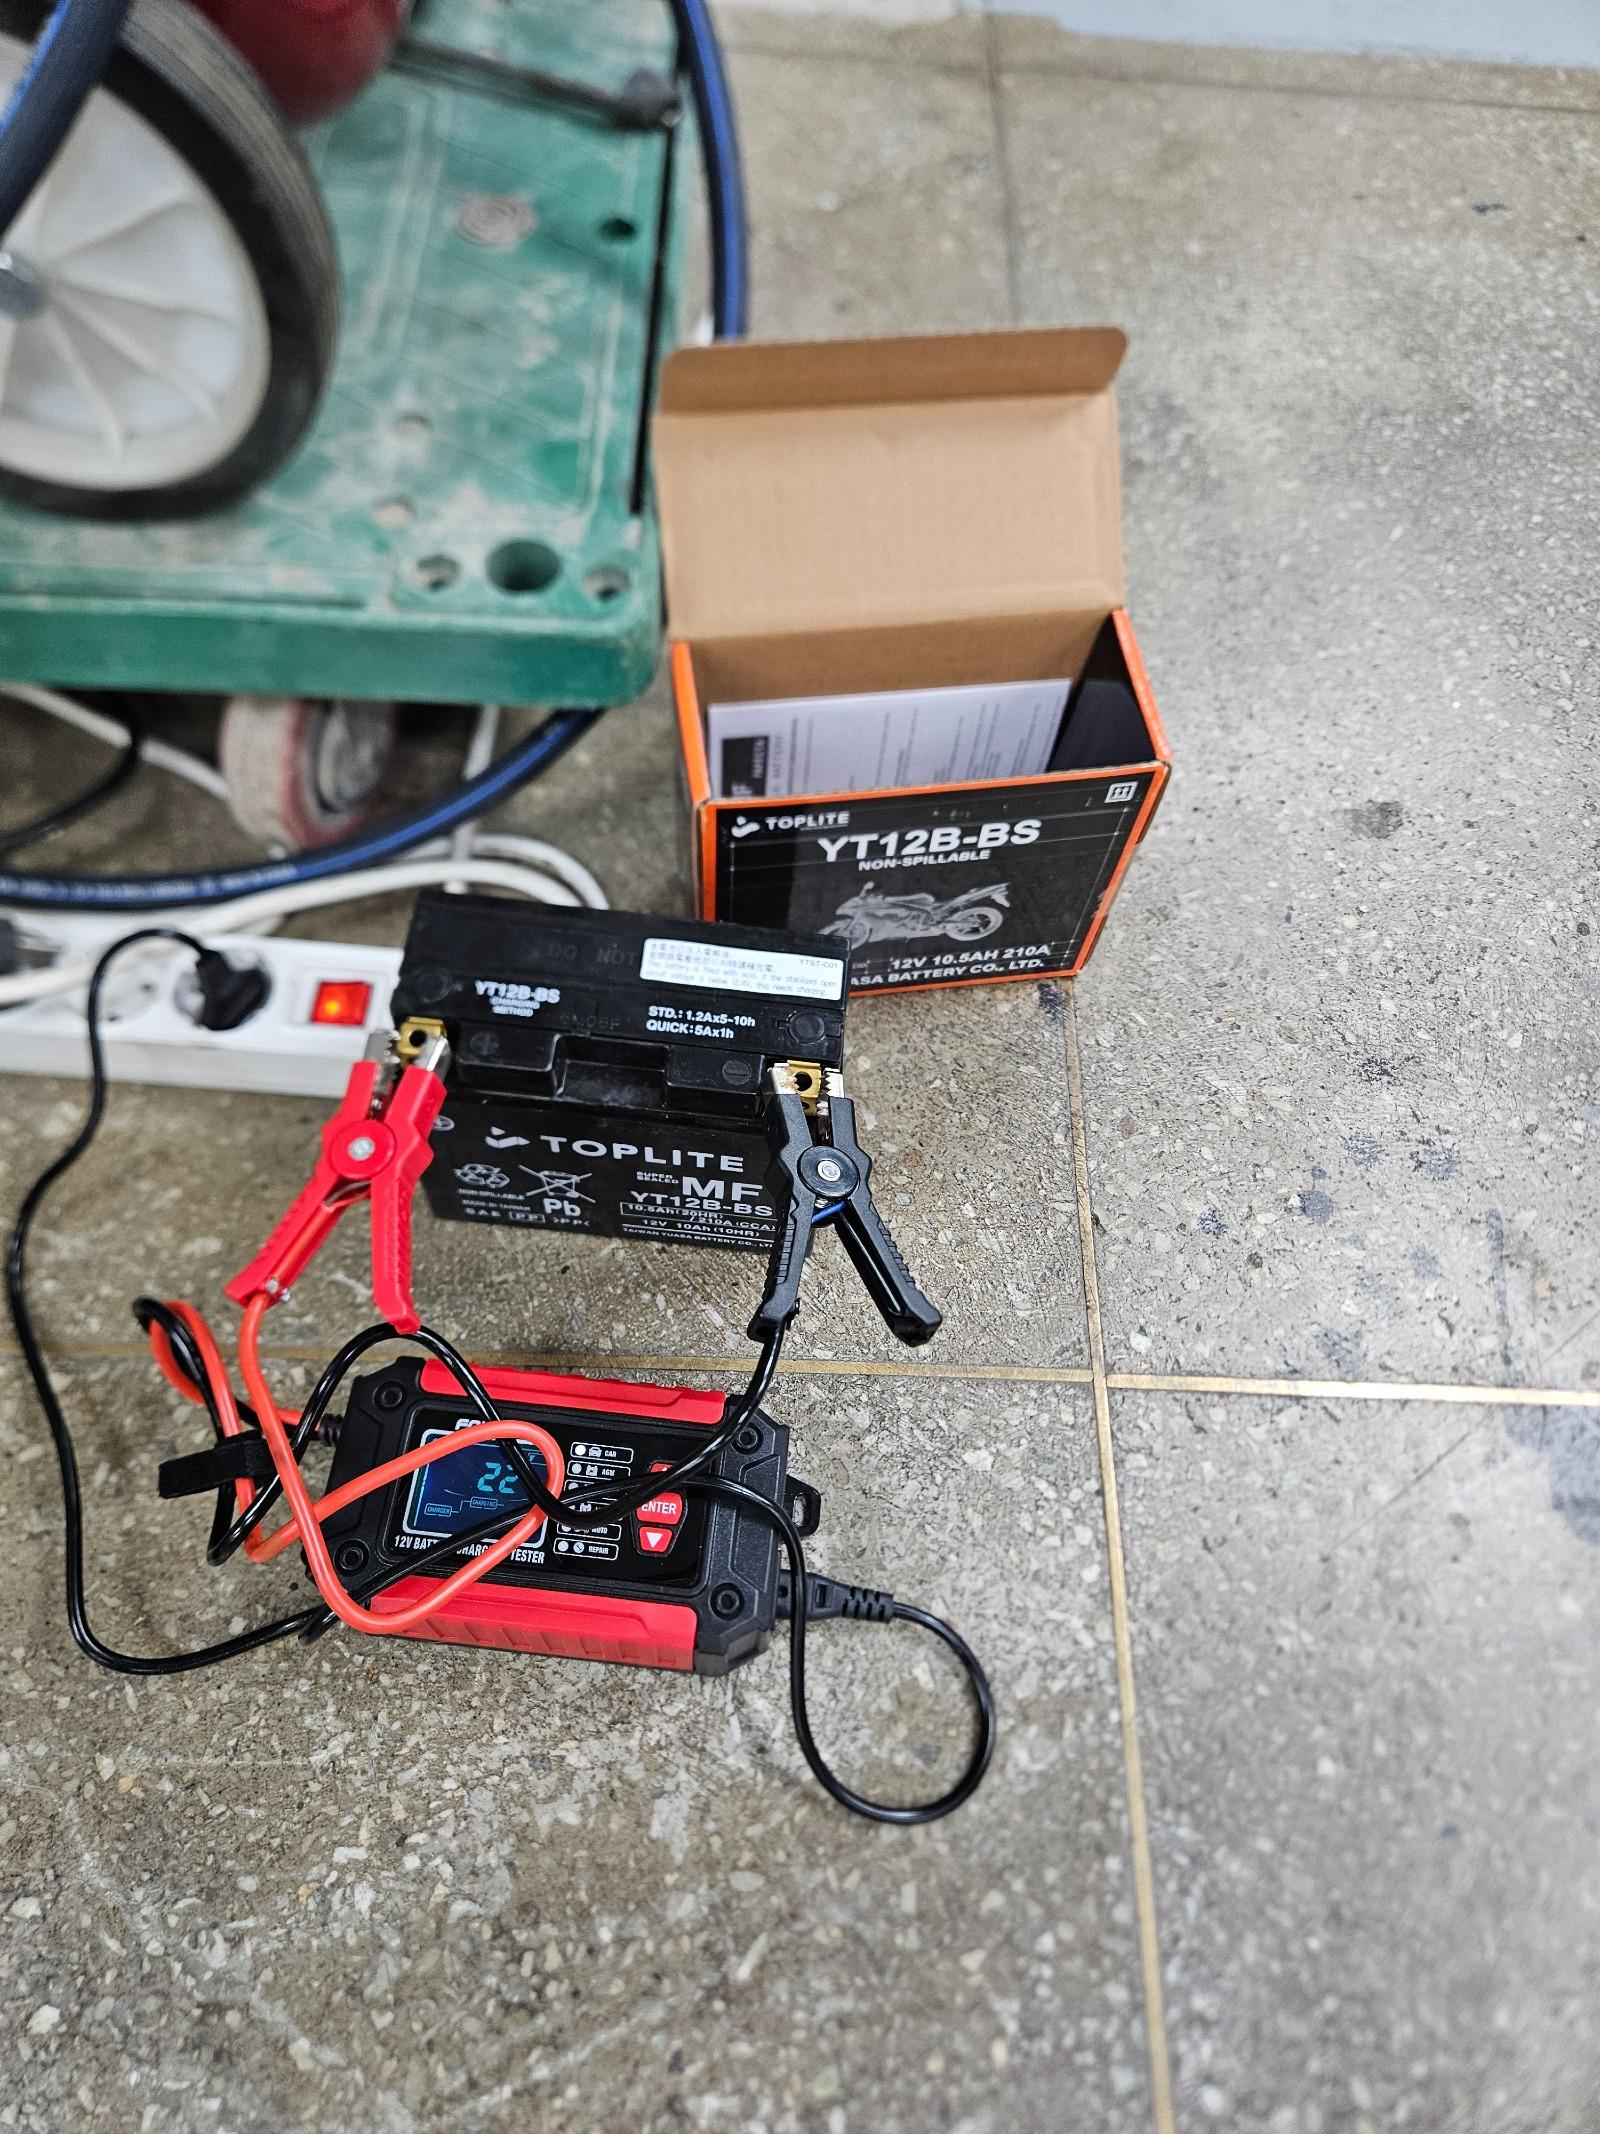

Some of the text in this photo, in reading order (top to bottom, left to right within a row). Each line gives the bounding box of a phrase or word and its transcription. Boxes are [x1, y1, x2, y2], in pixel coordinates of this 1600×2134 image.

[765, 811, 850, 830] TOPLITE
[817, 819, 1042, 862] YT12B-BS
[858, 850, 992, 871] NON-SPILLABLE
[891, 944, 1050, 970] 12V 10.5AH 210A
[851, 975, 883, 985] ASA
[888, 965, 966, 983] BATTERY
[1008, 958, 1044, 970] LTD.
[475, 980, 560, 1004] YT12B-BS
[489, 996, 540, 1010] CHARGING
[492, 1005, 533, 1017] METHOD
[540, 1134, 744, 1173] TOPLITE
[636, 1171, 673, 1179] SUPER
[636, 1176, 679, 1184] SEALED
[457, 1187, 525, 1200] NON-SPILLABLE
[682, 1176, 763, 1200] MF
[462, 1199, 486, 1207] MADE
[500, 1202, 531, 1211] TAIWAN
[543, 1197, 581, 1217] Pb
[630, 1191, 773, 1217] YT12B-BS
[642, 1219, 760, 1237] 12V 10Ah (10HR)
[736, 1222, 776, 1231] (CCA)
[623, 1227, 659, 1236] TAIWAN
[662, 1231, 692, 1239] YUASA
[694, 1234, 736, 1244] BATTERY
[604, 1449, 617, 1458] CAR
[601, 1468, 616, 1477] AGM
[426, 1506, 451, 1515] CHARGER
[472, 1499, 496, 1508] CHARGING
[641, 1500, 677, 1515] ENTER
[394, 1535, 413, 1549] 12V
[510, 1549, 545, 1564] TESTER
[588, 1545, 609, 1555] REPAIR
